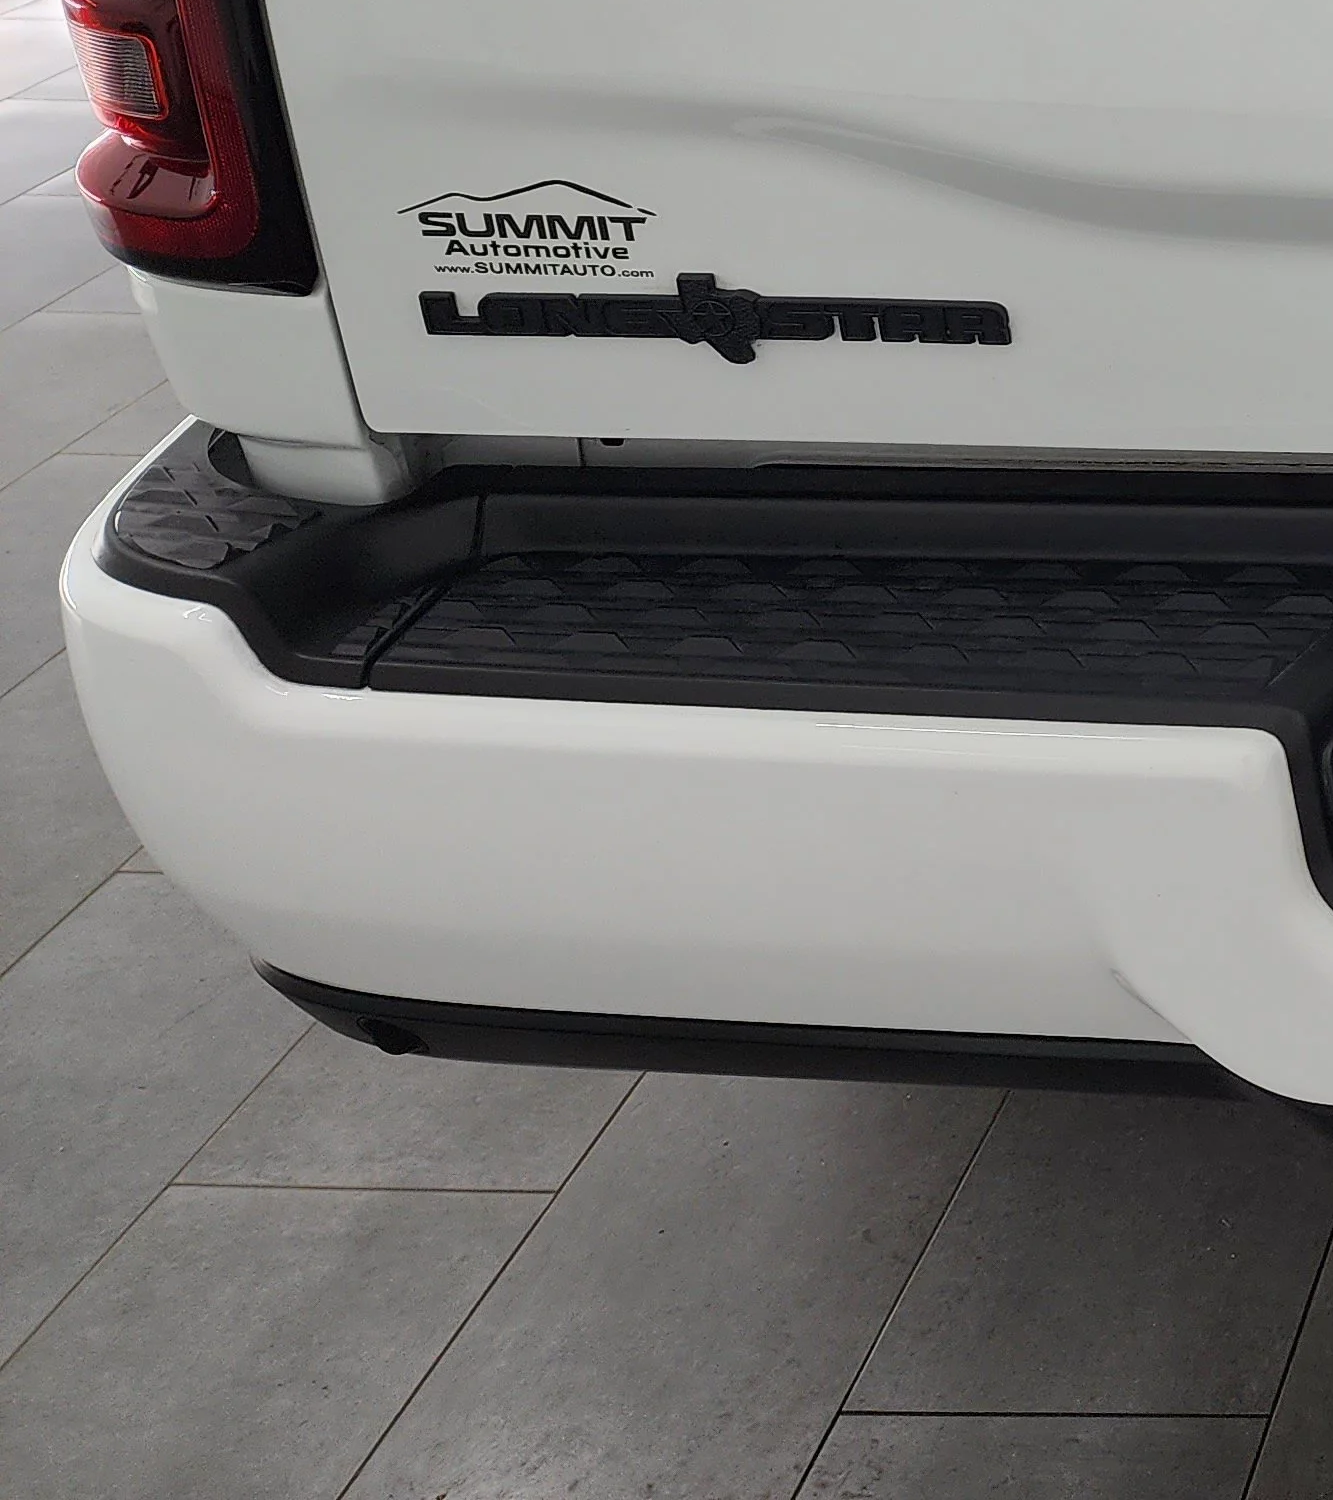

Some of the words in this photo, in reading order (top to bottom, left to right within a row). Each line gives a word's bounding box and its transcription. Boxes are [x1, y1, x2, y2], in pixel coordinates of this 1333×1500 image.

[418, 211, 648, 242] SUMMIT
[444, 239, 630, 261] Automotive
[433, 261, 655, 279] www.SUMMITAUTO.com
[419, 291, 676, 338] LONE
[759, 297, 1012, 346] STAR
